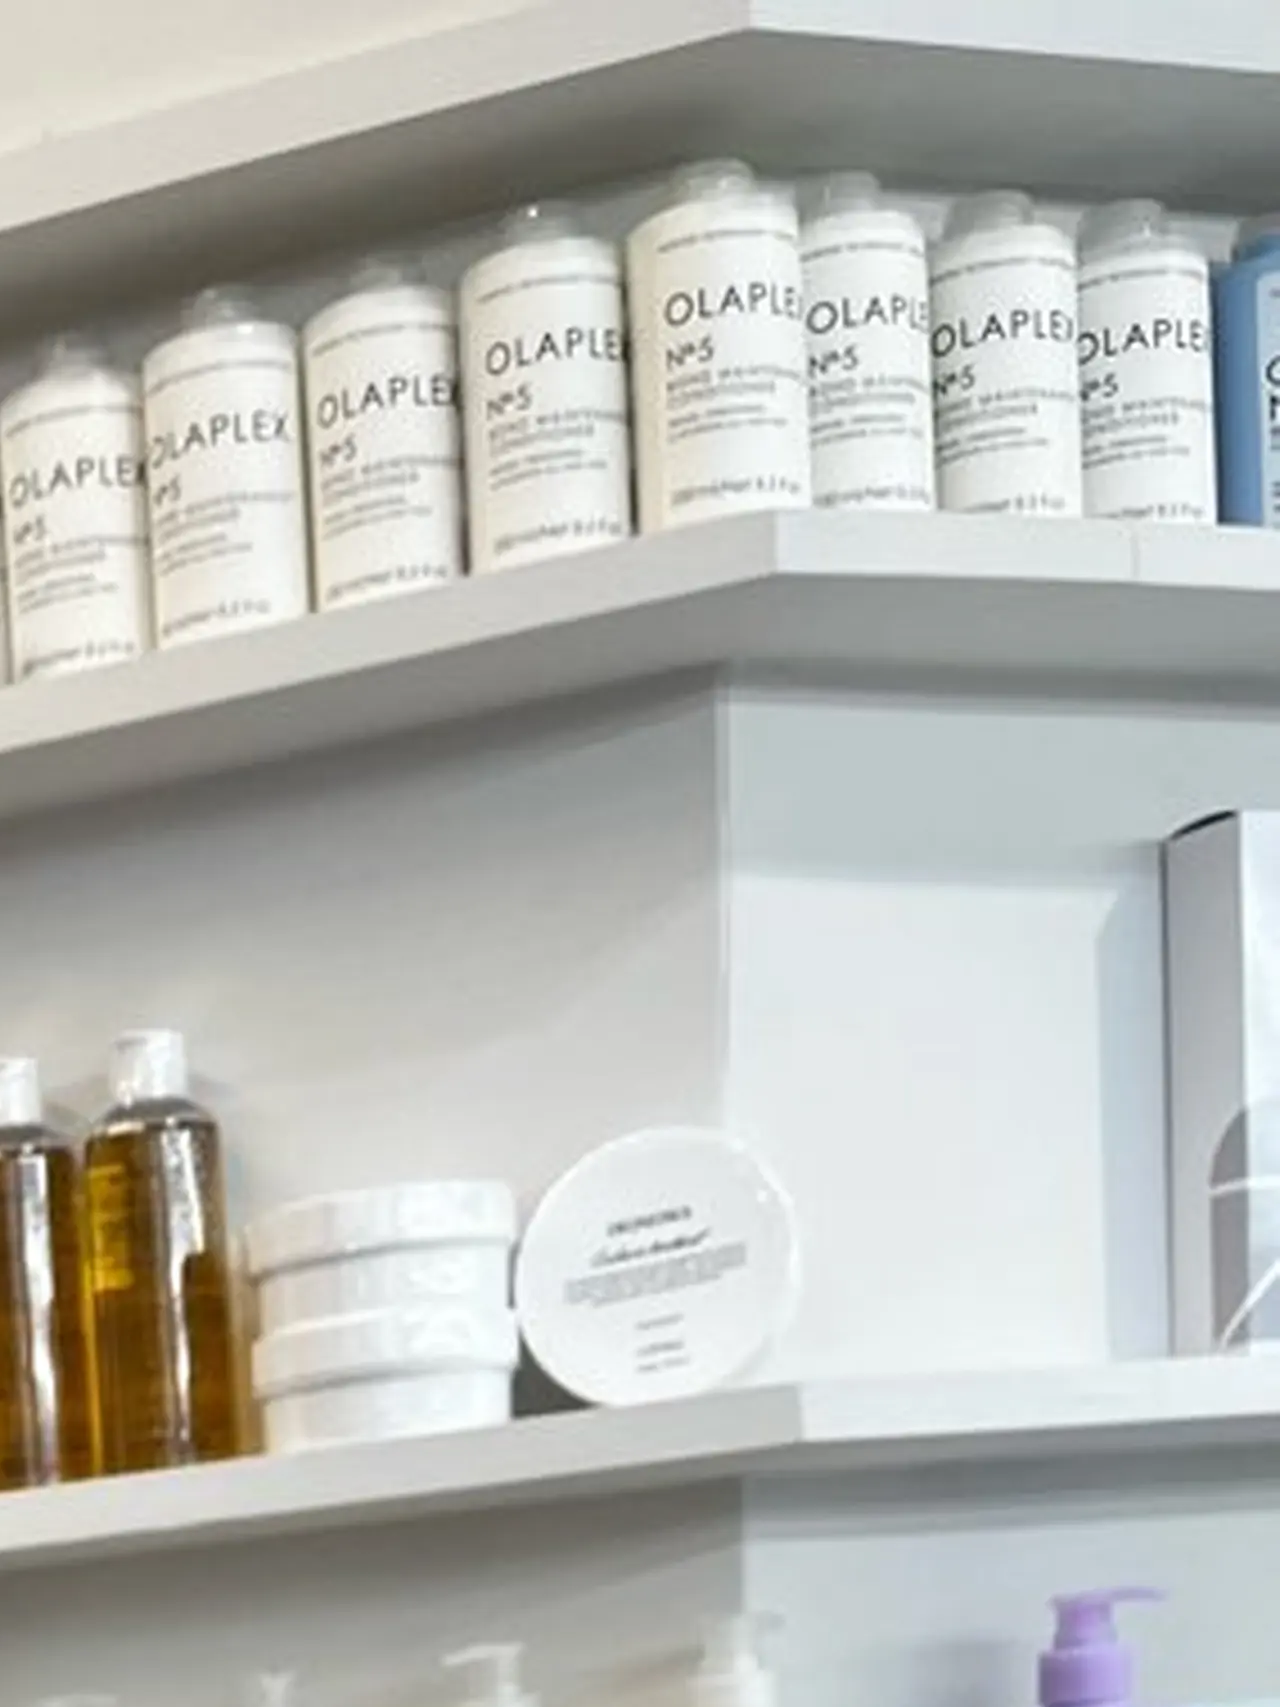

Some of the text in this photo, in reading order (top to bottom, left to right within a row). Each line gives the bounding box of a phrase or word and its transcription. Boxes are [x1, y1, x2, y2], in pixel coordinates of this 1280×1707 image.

[806, 293, 929, 335] OLAPLE
[485, 327, 626, 376] OLAPLE
[1078, 319, 1203, 367] OLAPLE
